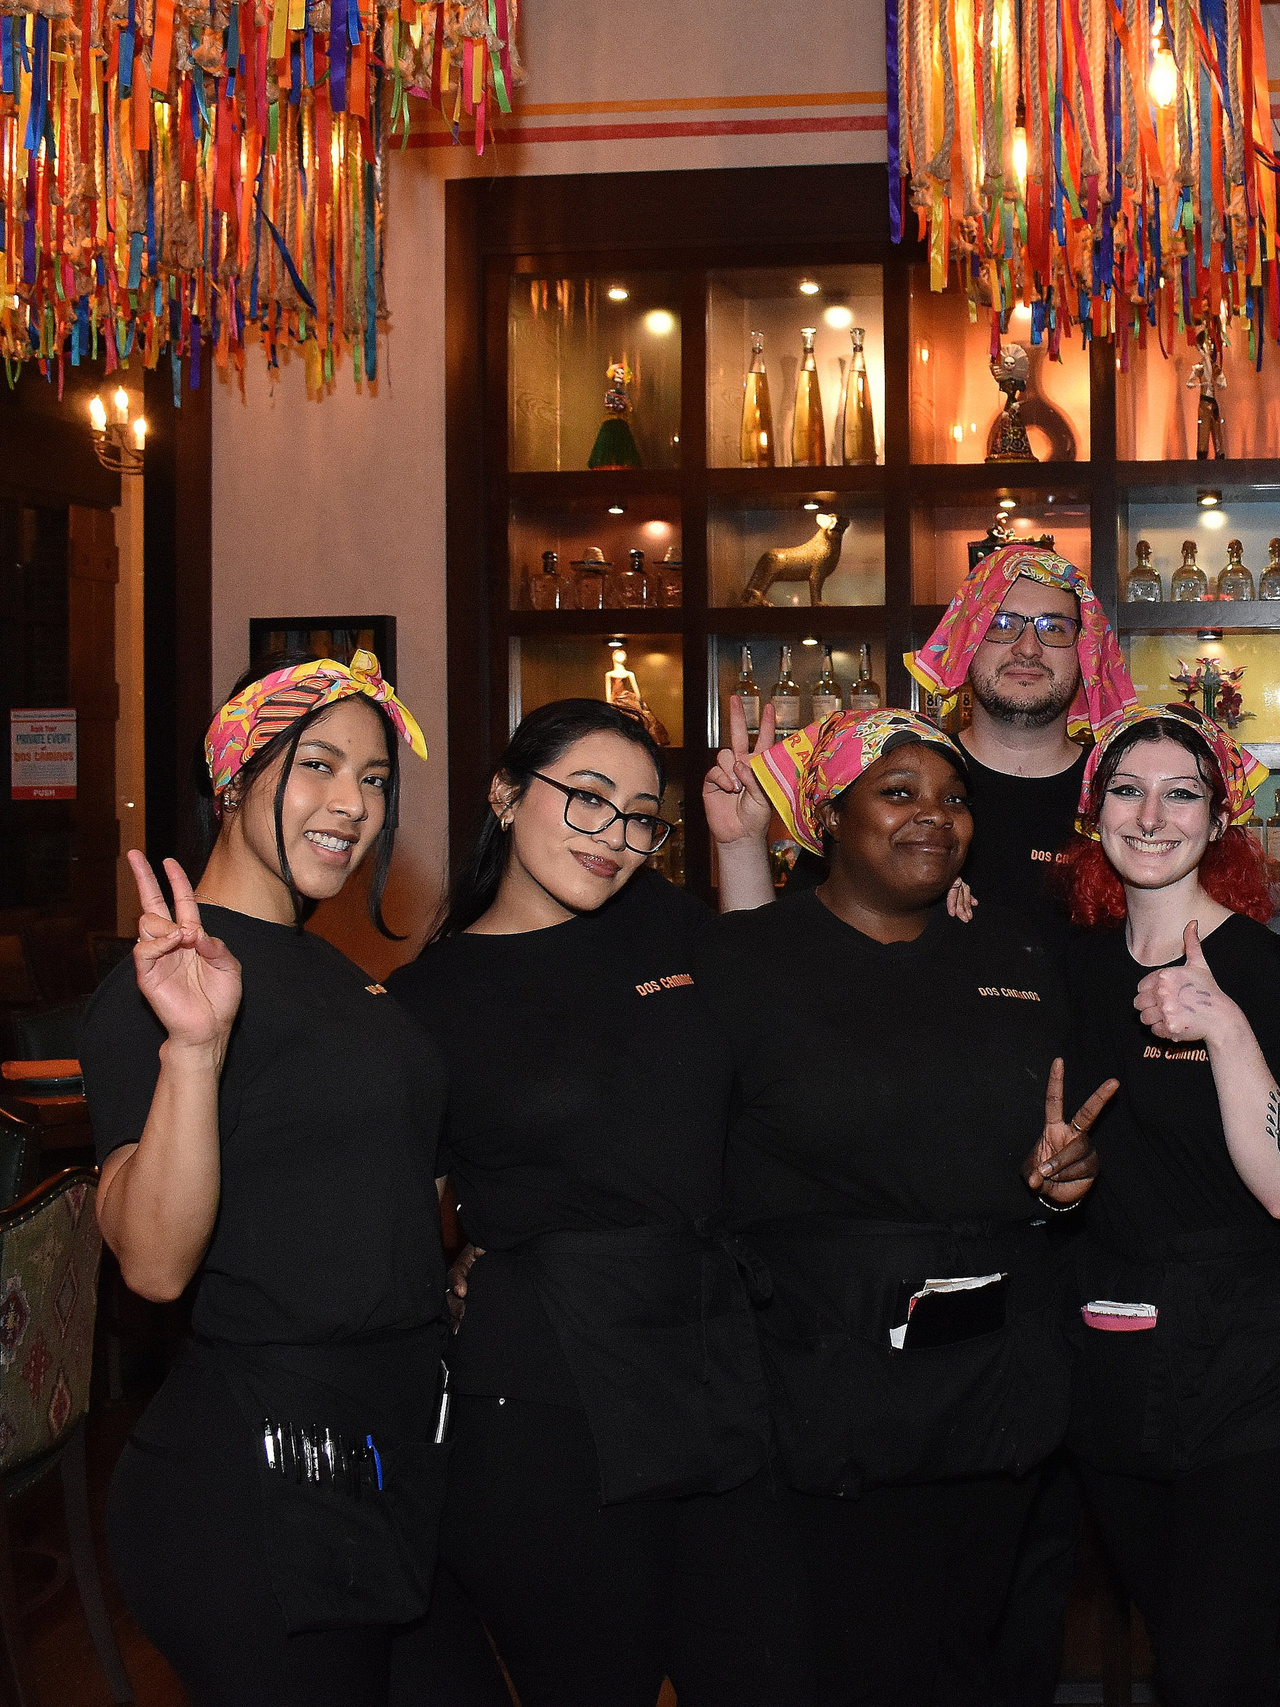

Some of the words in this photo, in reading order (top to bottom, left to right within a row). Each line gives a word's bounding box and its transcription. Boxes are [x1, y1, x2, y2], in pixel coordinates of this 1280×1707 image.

[14, 752, 31, 762] DOS
[1031, 849, 1052, 862] DOS
[635, 980, 661, 997] DOS
[978, 987, 1000, 997] DOS
[1143, 1045, 1162, 1059] DOS
[1164, 1048, 1209, 1062] CAMINO
